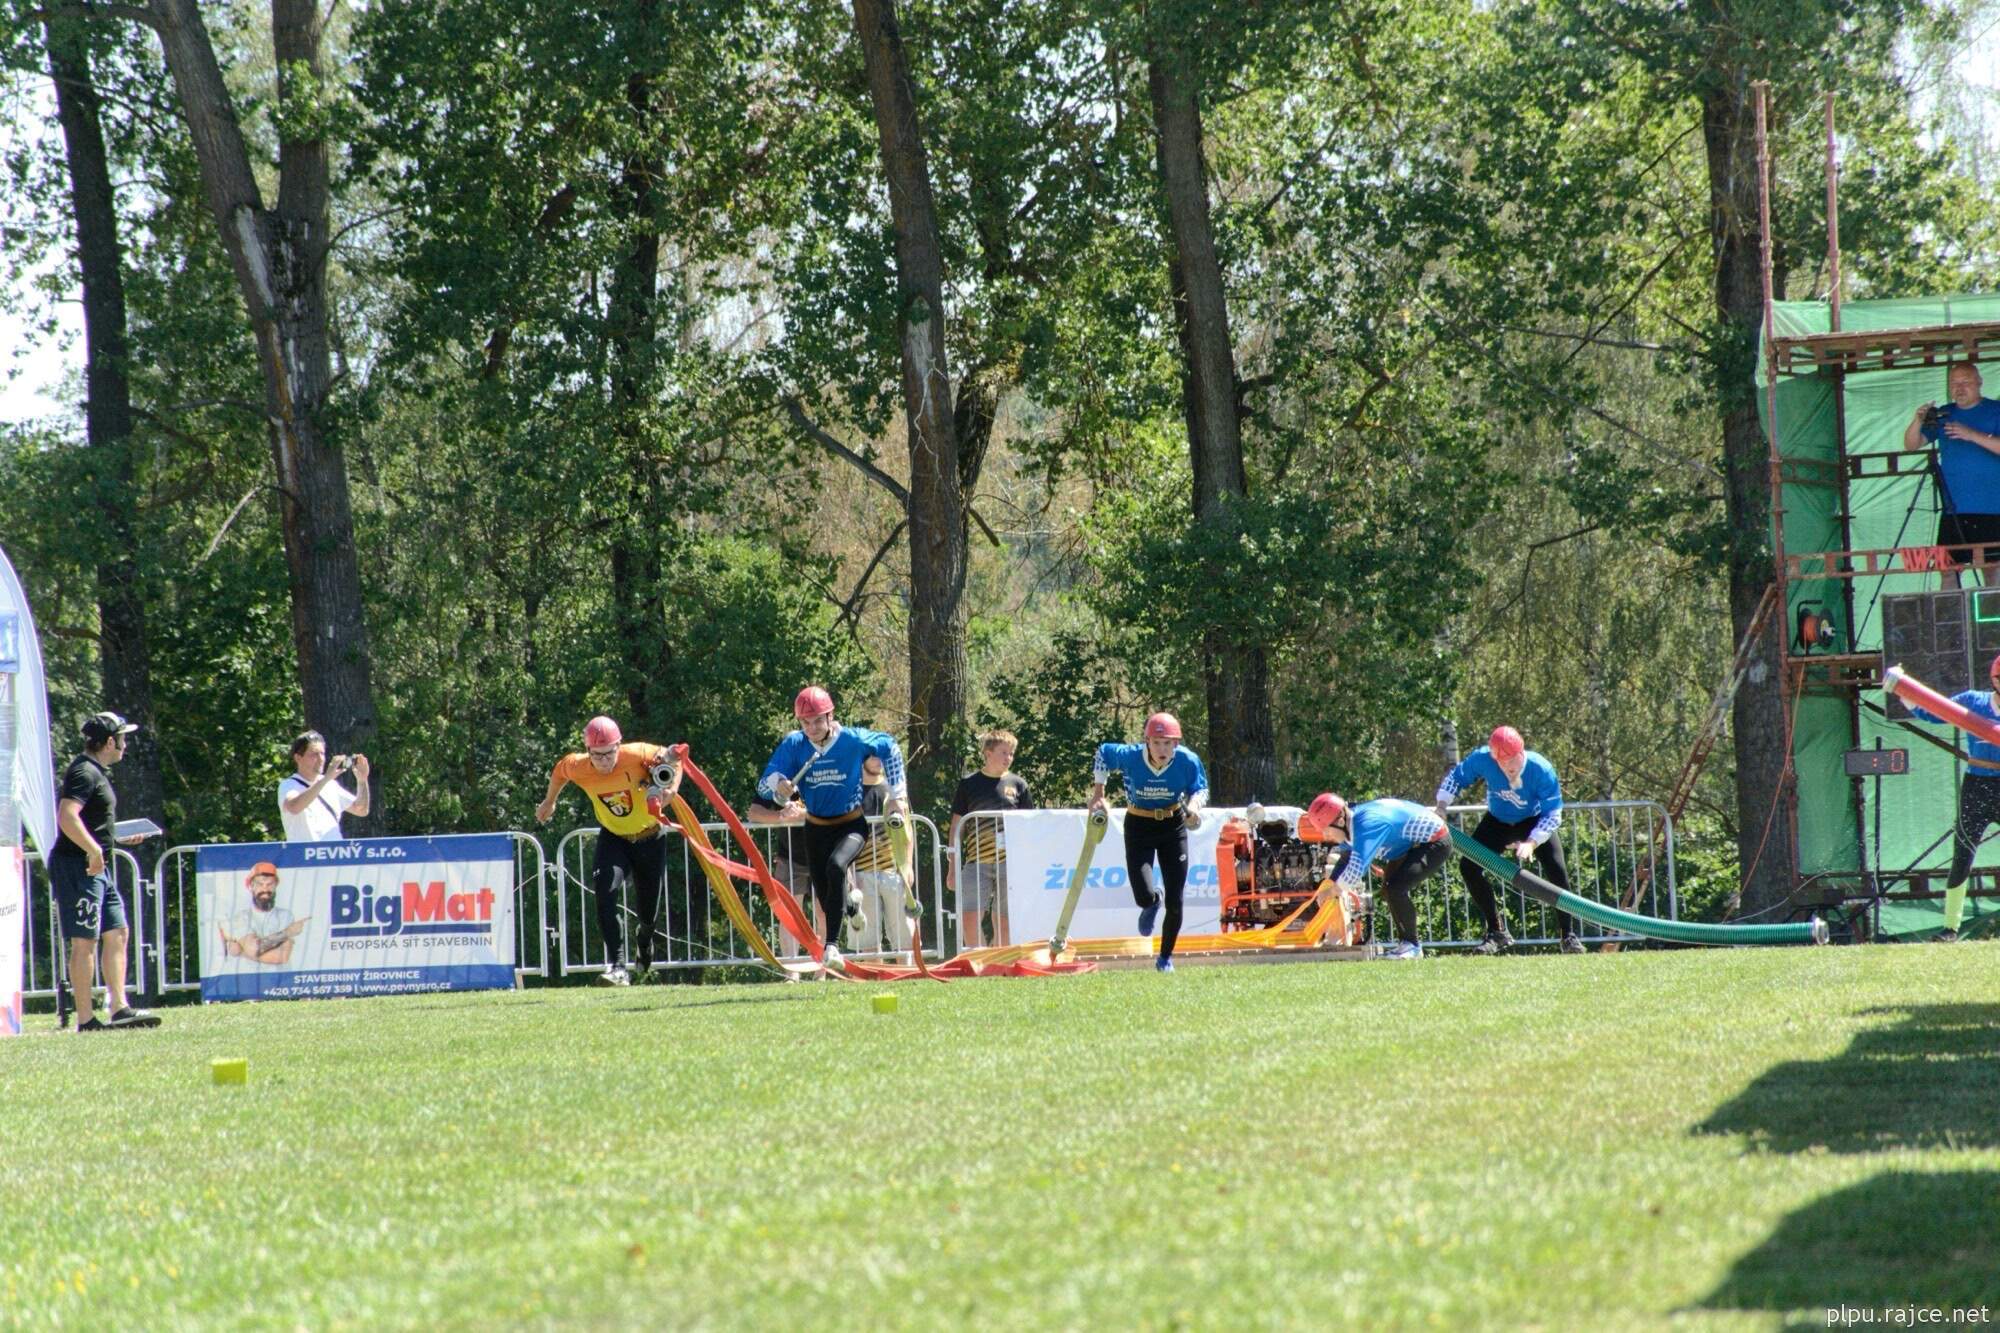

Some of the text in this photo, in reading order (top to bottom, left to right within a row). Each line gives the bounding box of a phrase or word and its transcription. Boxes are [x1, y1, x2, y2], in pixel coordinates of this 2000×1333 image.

[304, 842, 406, 861] PEVNÝ s.r.o.
[331, 882, 495, 937] BigMat
[330, 937, 398, 951] EVROPSKÁ
[423, 936, 493, 947] STAVEBNIN
[294, 970, 420, 984] STAVEBNINY ŽIROVNICE
[263, 986, 289, 997] +420
